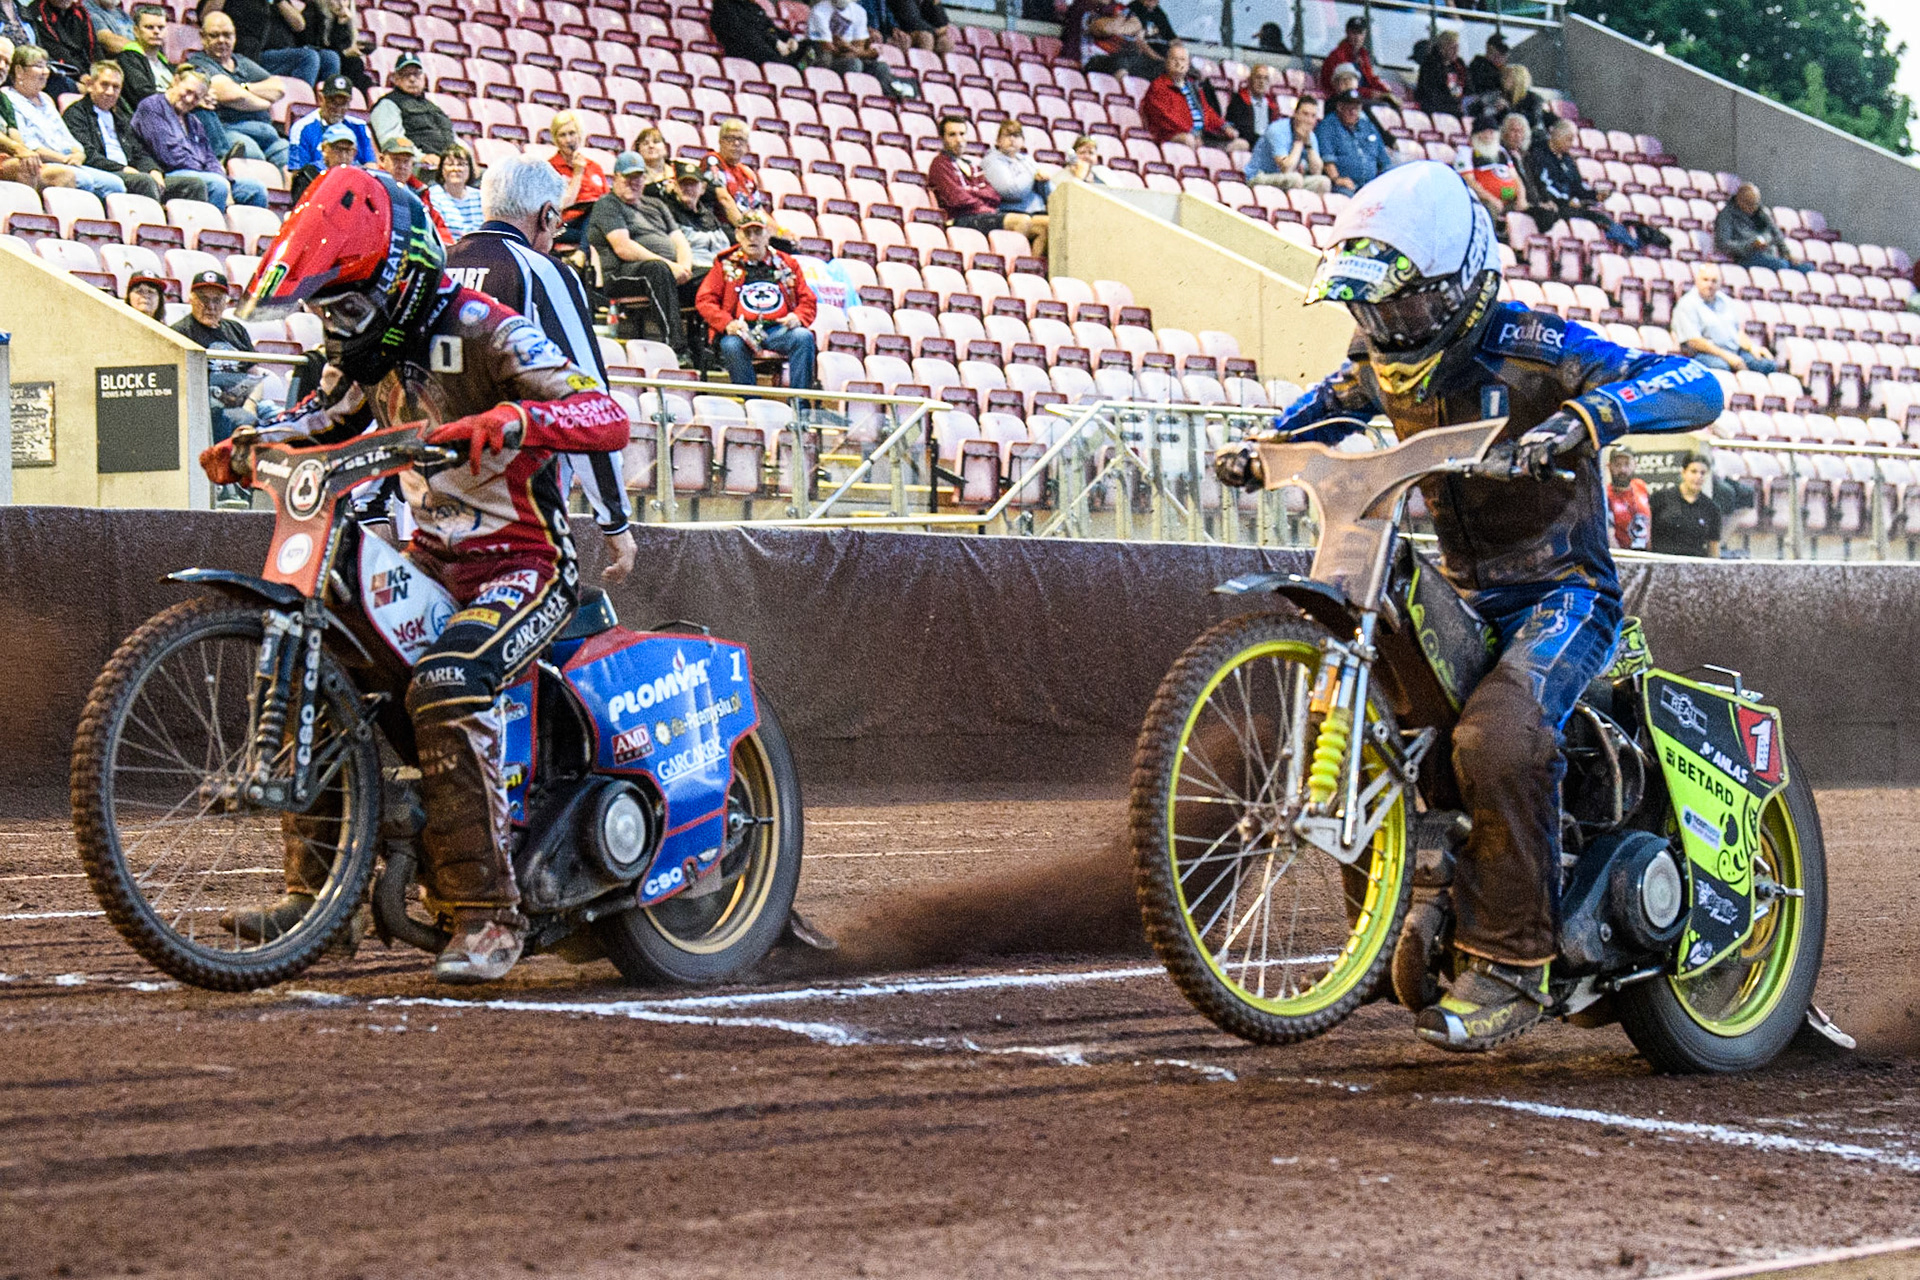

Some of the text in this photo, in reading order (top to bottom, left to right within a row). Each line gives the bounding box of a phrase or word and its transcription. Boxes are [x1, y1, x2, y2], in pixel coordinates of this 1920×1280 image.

[377, 231, 405, 293] LEATT
[445, 267, 490, 292] TART
[440, 341, 452, 367] 1
[100, 372, 157, 390] BLOCK E
[392, 616, 427, 646] NGK
[729, 651, 744, 682] 1
[657, 737, 726, 780] GARCAREK
[1750, 718, 1773, 772] 1
[1678, 755, 1735, 808] BETARD
[1712, 750, 1749, 784] ANLAS
